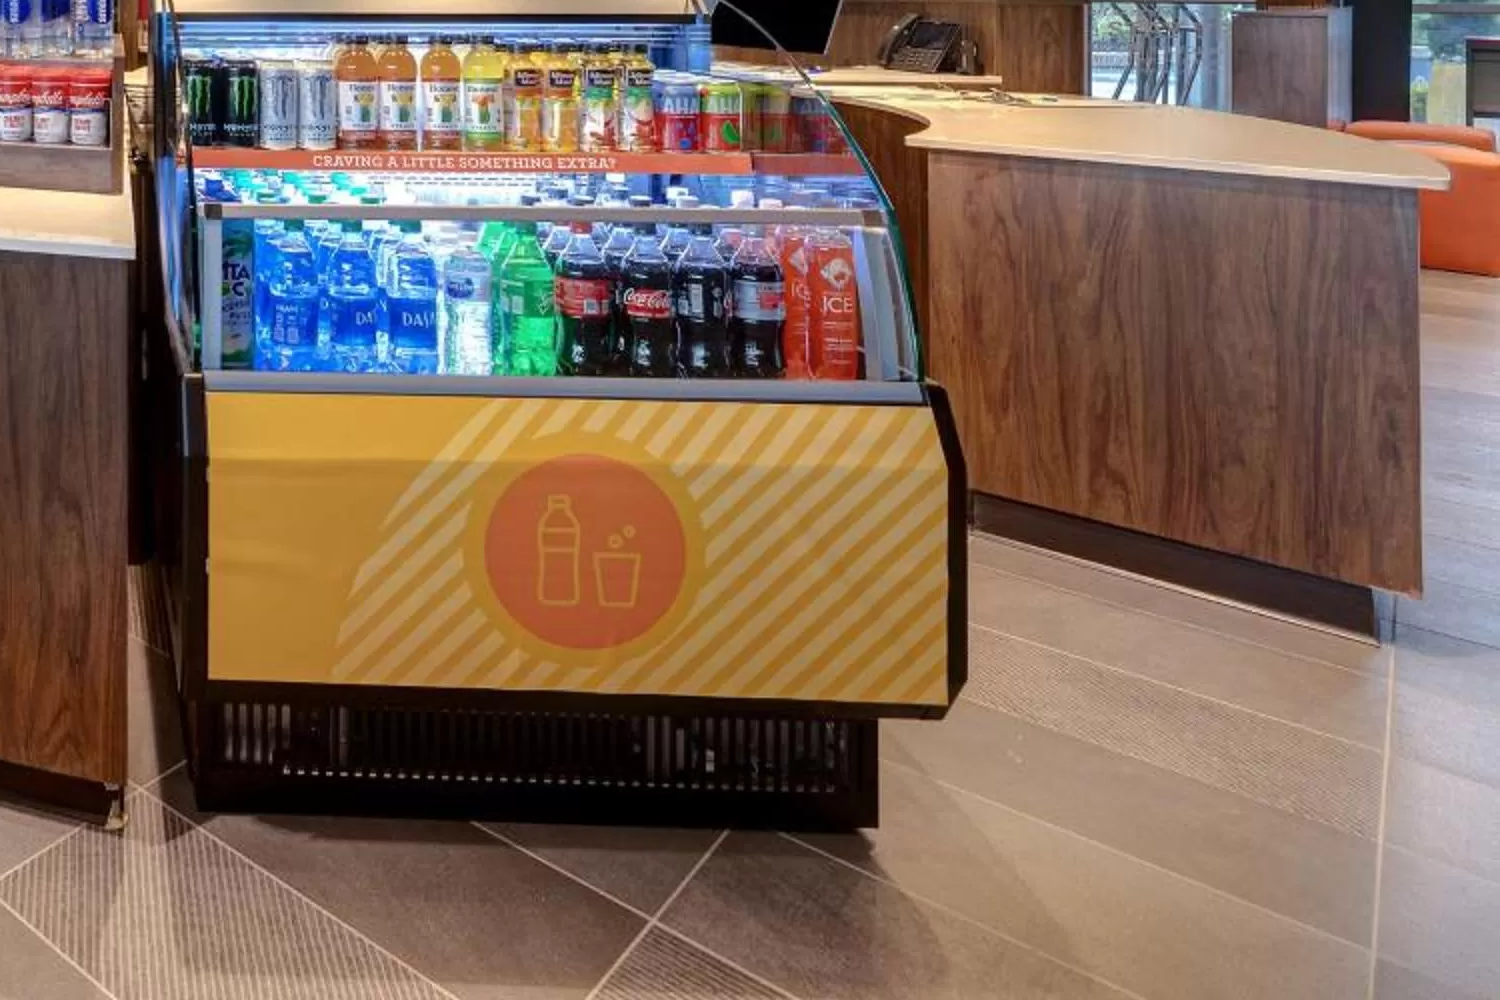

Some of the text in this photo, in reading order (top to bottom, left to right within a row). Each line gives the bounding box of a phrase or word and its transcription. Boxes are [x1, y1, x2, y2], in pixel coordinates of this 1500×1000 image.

[312, 155, 616, 170] CRAVING A LITTLE SOMETHING EXTRA?
[222, 261, 250, 281] ITA
[821, 295, 854, 313] ICE
